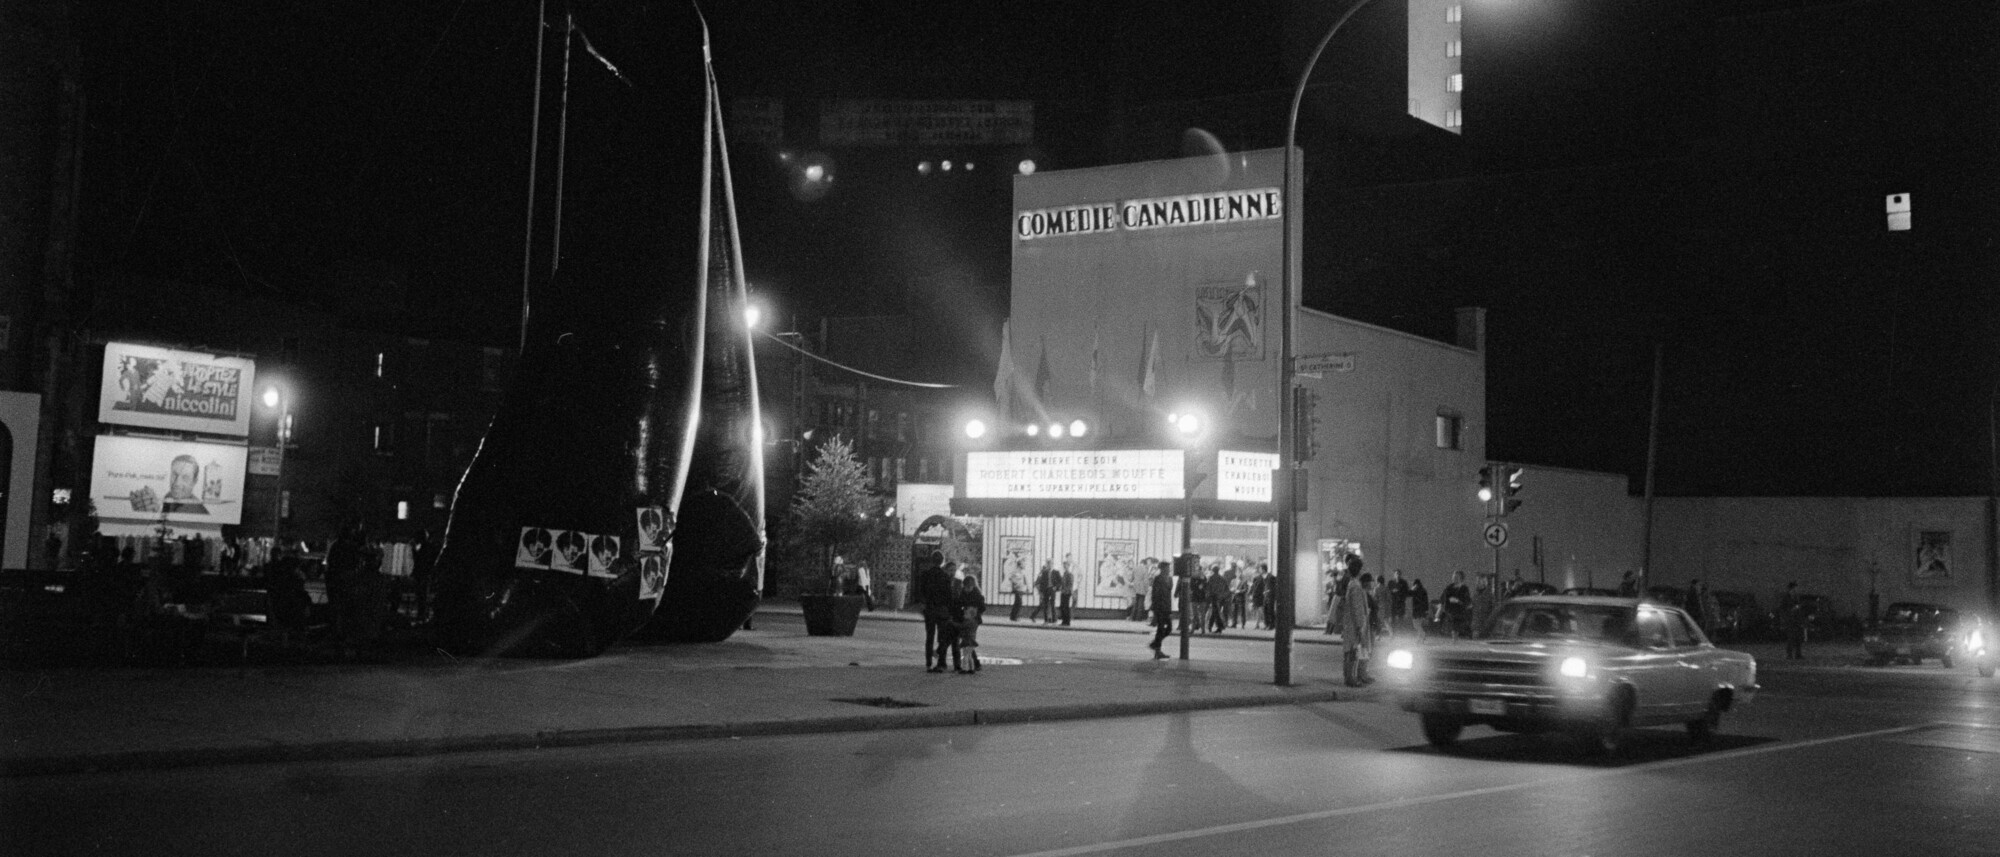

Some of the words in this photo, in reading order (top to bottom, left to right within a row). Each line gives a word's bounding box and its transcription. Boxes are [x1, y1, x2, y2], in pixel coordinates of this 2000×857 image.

[1018, 206, 1114, 236] COMEDIE
[1123, 192, 1279, 227] CANADIENNE
[203, 381, 237, 397] STYLE
[165, 394, 236, 416] niccolini
[1021, 456, 1070, 465] PREMIERE
[1077, 456, 1090, 465] CE
[1093, 456, 1118, 465] SOIR
[1225, 456, 1235, 466] EN
[1239, 457, 1273, 468] VEDETTE
[980, 469, 1026, 480] ROBERT
[1032, 469, 1107, 480] CHARLEBOIS
[1111, 468, 1166, 479] MOUFFE
[1225, 471, 1271, 481] CHARLEBOI
[1008, 483, 1032, 493] DANS
